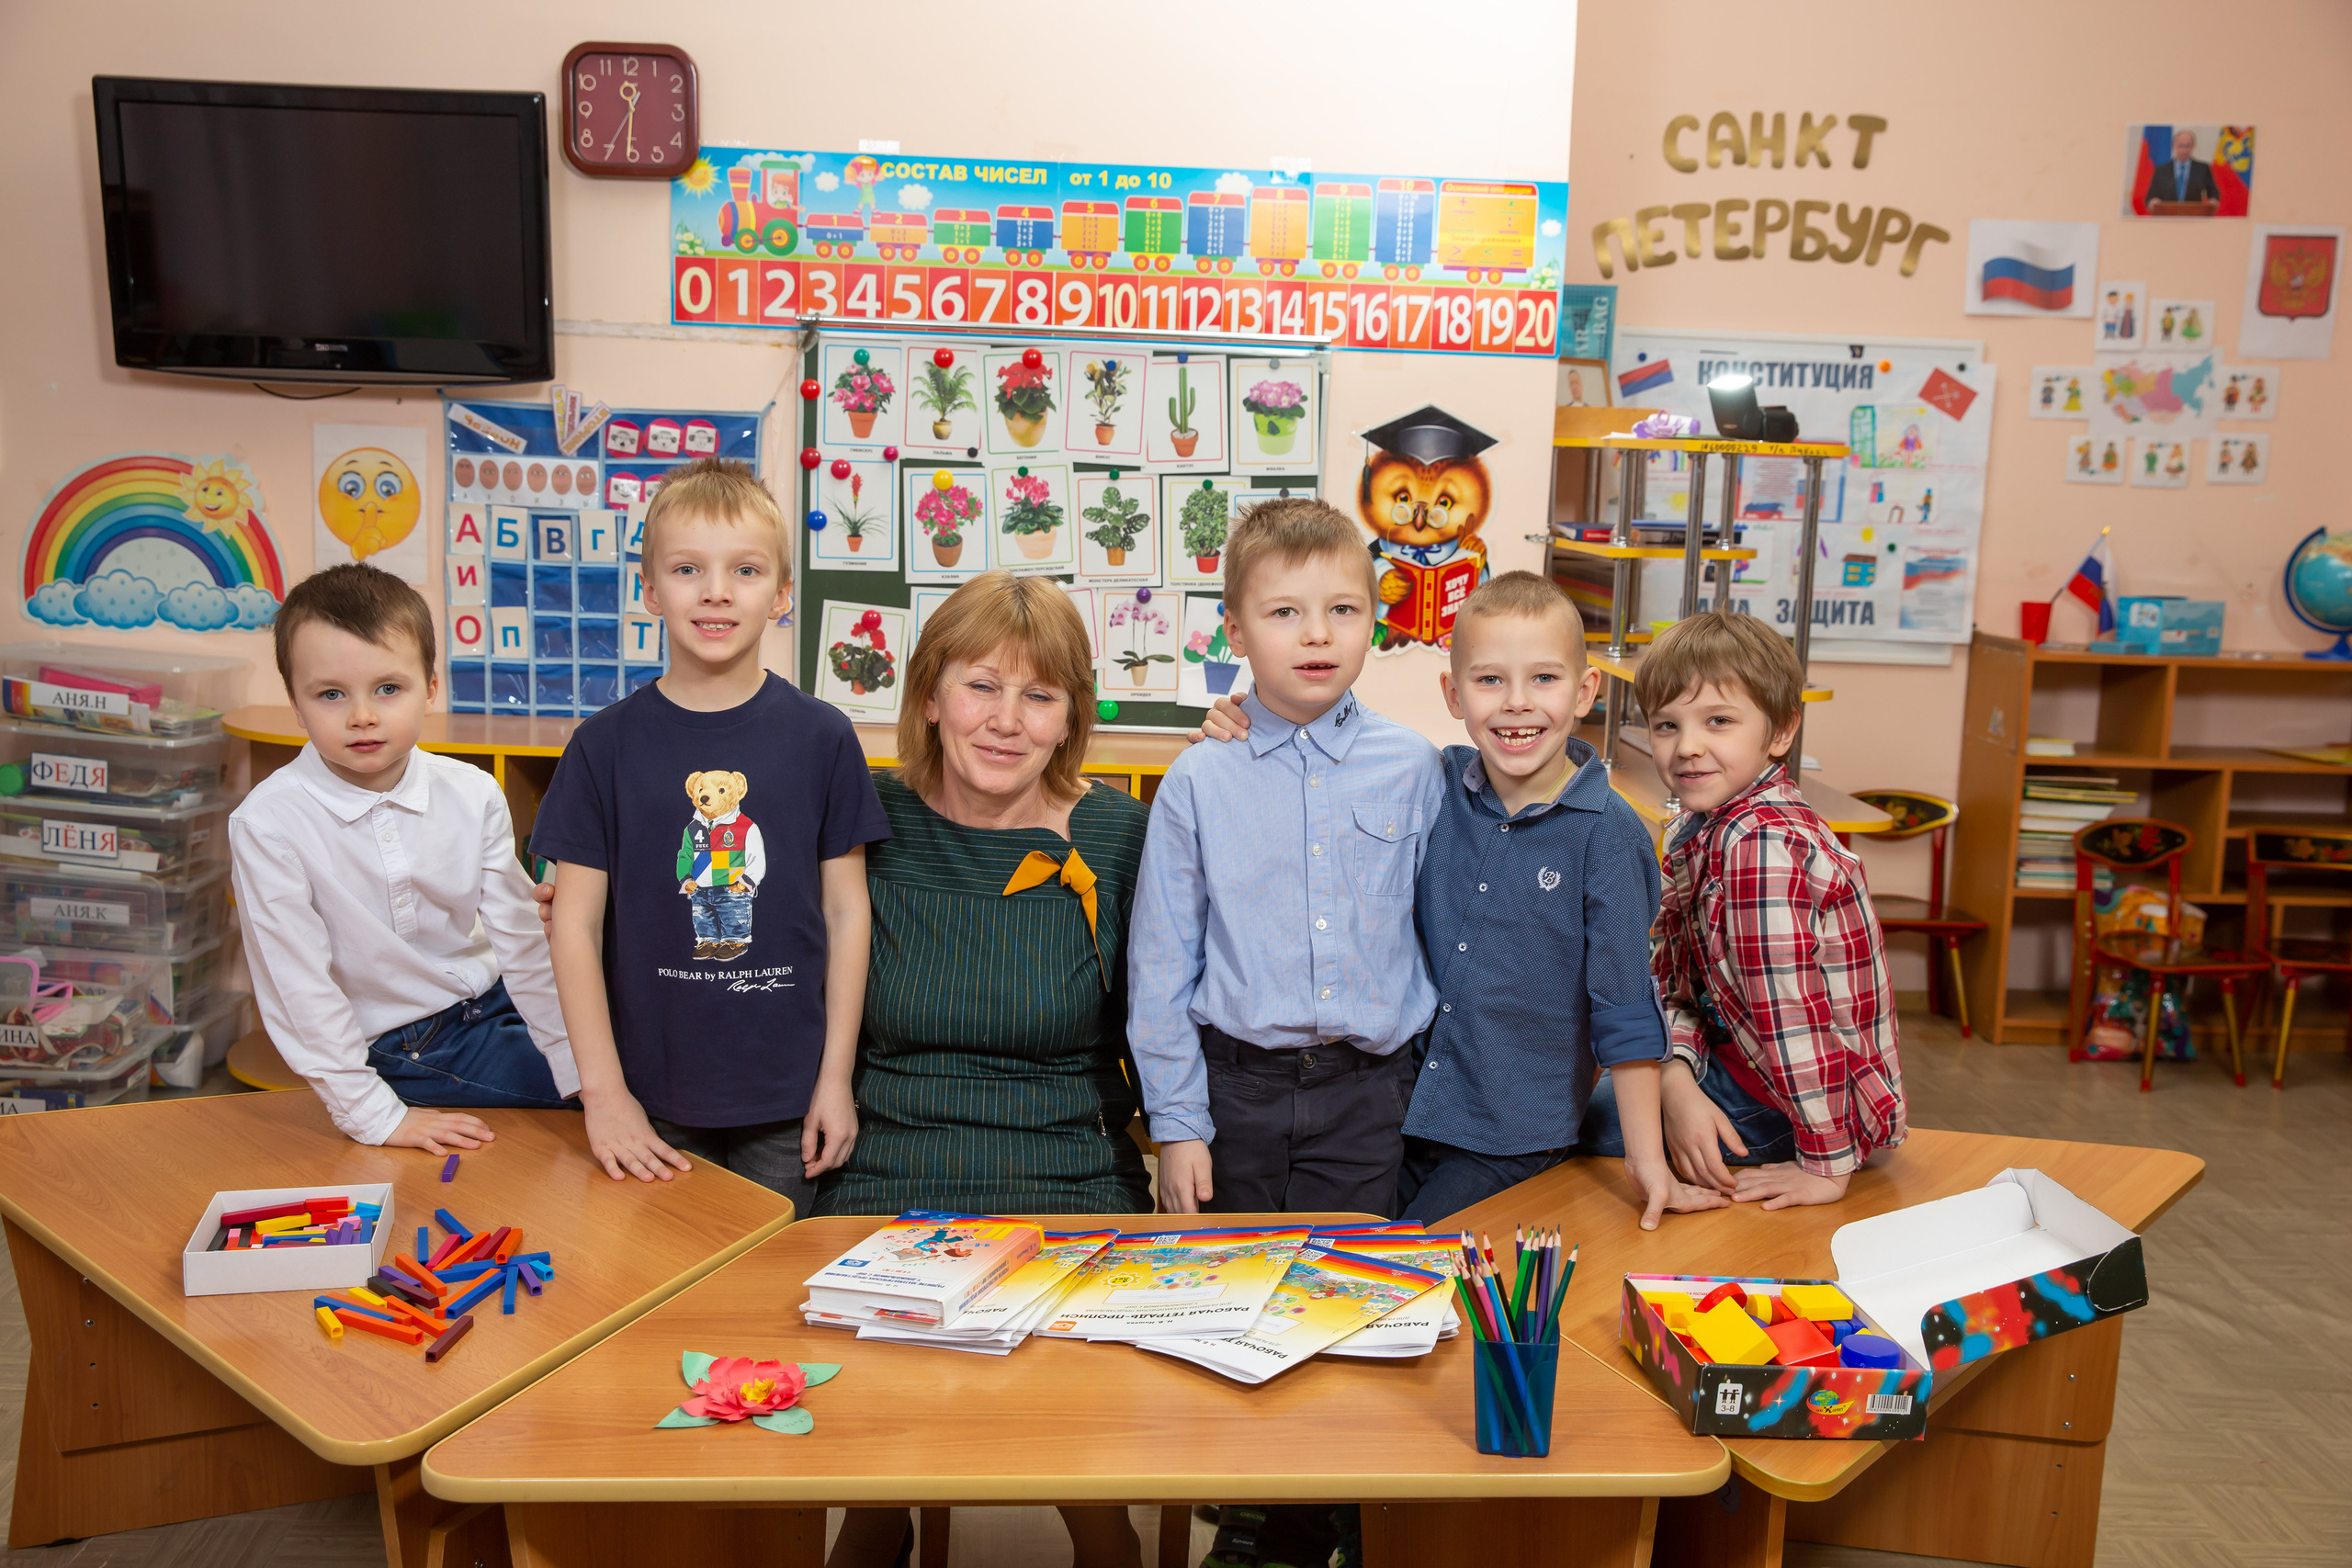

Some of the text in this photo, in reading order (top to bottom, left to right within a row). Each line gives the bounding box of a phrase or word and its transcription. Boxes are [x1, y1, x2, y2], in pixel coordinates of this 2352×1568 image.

[600, 59, 612, 76] 11
[623, 57, 639, 75] 12
[652, 61, 658, 77] 1
[579, 73, 596, 91] 10
[670, 74, 684, 93] 2
[579, 101, 593, 118] 9
[671, 104, 685, 122] 3
[581, 129, 594, 148] 8
[670, 131, 682, 149] 4
[1662, 111, 1887, 173] САНКТ
[604, 144, 616, 161] 7
[650, 146, 664, 164] 5
[882, 163, 1172, 189] СОСТАВ ЧИСЕЛ от 1 до 10
[1277, 189, 1284, 199] 8
[1340, 184, 1348, 195] 9
[1400, 180, 1415, 191] 10
[1150, 198, 1158, 208] 6
[1214, 194, 1222, 204] 7
[959, 210, 967, 220] 3
[1021, 208, 1029, 219] 4
[1087, 204, 1095, 213] 5
[832, 216, 838, 226] 1
[895, 213, 903, 224] 2
[1592, 198, 1951, 279] ПЕТЕРБУРГ
[679, 265, 712, 314] 0
[728, 268, 747, 316] 1
[764, 269, 797, 318] 2
[808, 270, 838, 318] 3
[847, 274, 882, 318] 4
[891, 275, 921, 320] 5
[930, 276, 965, 321] 6
[974, 278, 1007, 323] 7
[1014, 278, 1049, 325] 8
[1058, 280, 1093, 327] 9
[1099, 282, 1137, 329] 10
[1141, 284, 1178, 331] 11
[1182, 286, 1222, 333] 12
[1225, 287, 1263, 333] 13
[1266, 288, 1305, 334] 14
[1308, 291, 1347, 340] 15
[1351, 292, 1389, 342] 16
[1391, 293, 1431, 343] 17
[1433, 296, 1472, 345] 18
[1476, 297, 1514, 345] 19
[1516, 299, 1556, 347] 20
[562, 408, 609, 453] ВТОРНИК
[456, 513, 481, 544] А
[496, 518, 520, 547] Б
[546, 527, 566, 553] В
[1445, 573, 1470, 592] ХОЧУ
[1777, 598, 1875, 627] ЗЩИТА
[456, 615, 482, 645] О
[631, 621, 652, 650] Т
[52, 692, 107, 709] АНЯ.Н
[33, 761, 107, 790] ФЕДЯ
[43, 825, 116, 852] ЛЁНЯ
[53, 904, 107, 920] АНЯ.К
[658, 966, 794, 981] POLO BEAR by RALPH LAUREN
[1189, 1306, 1250, 1315] РАБОЧАЯ
[1235, 1340, 1288, 1359] РАБОЧАЯ
